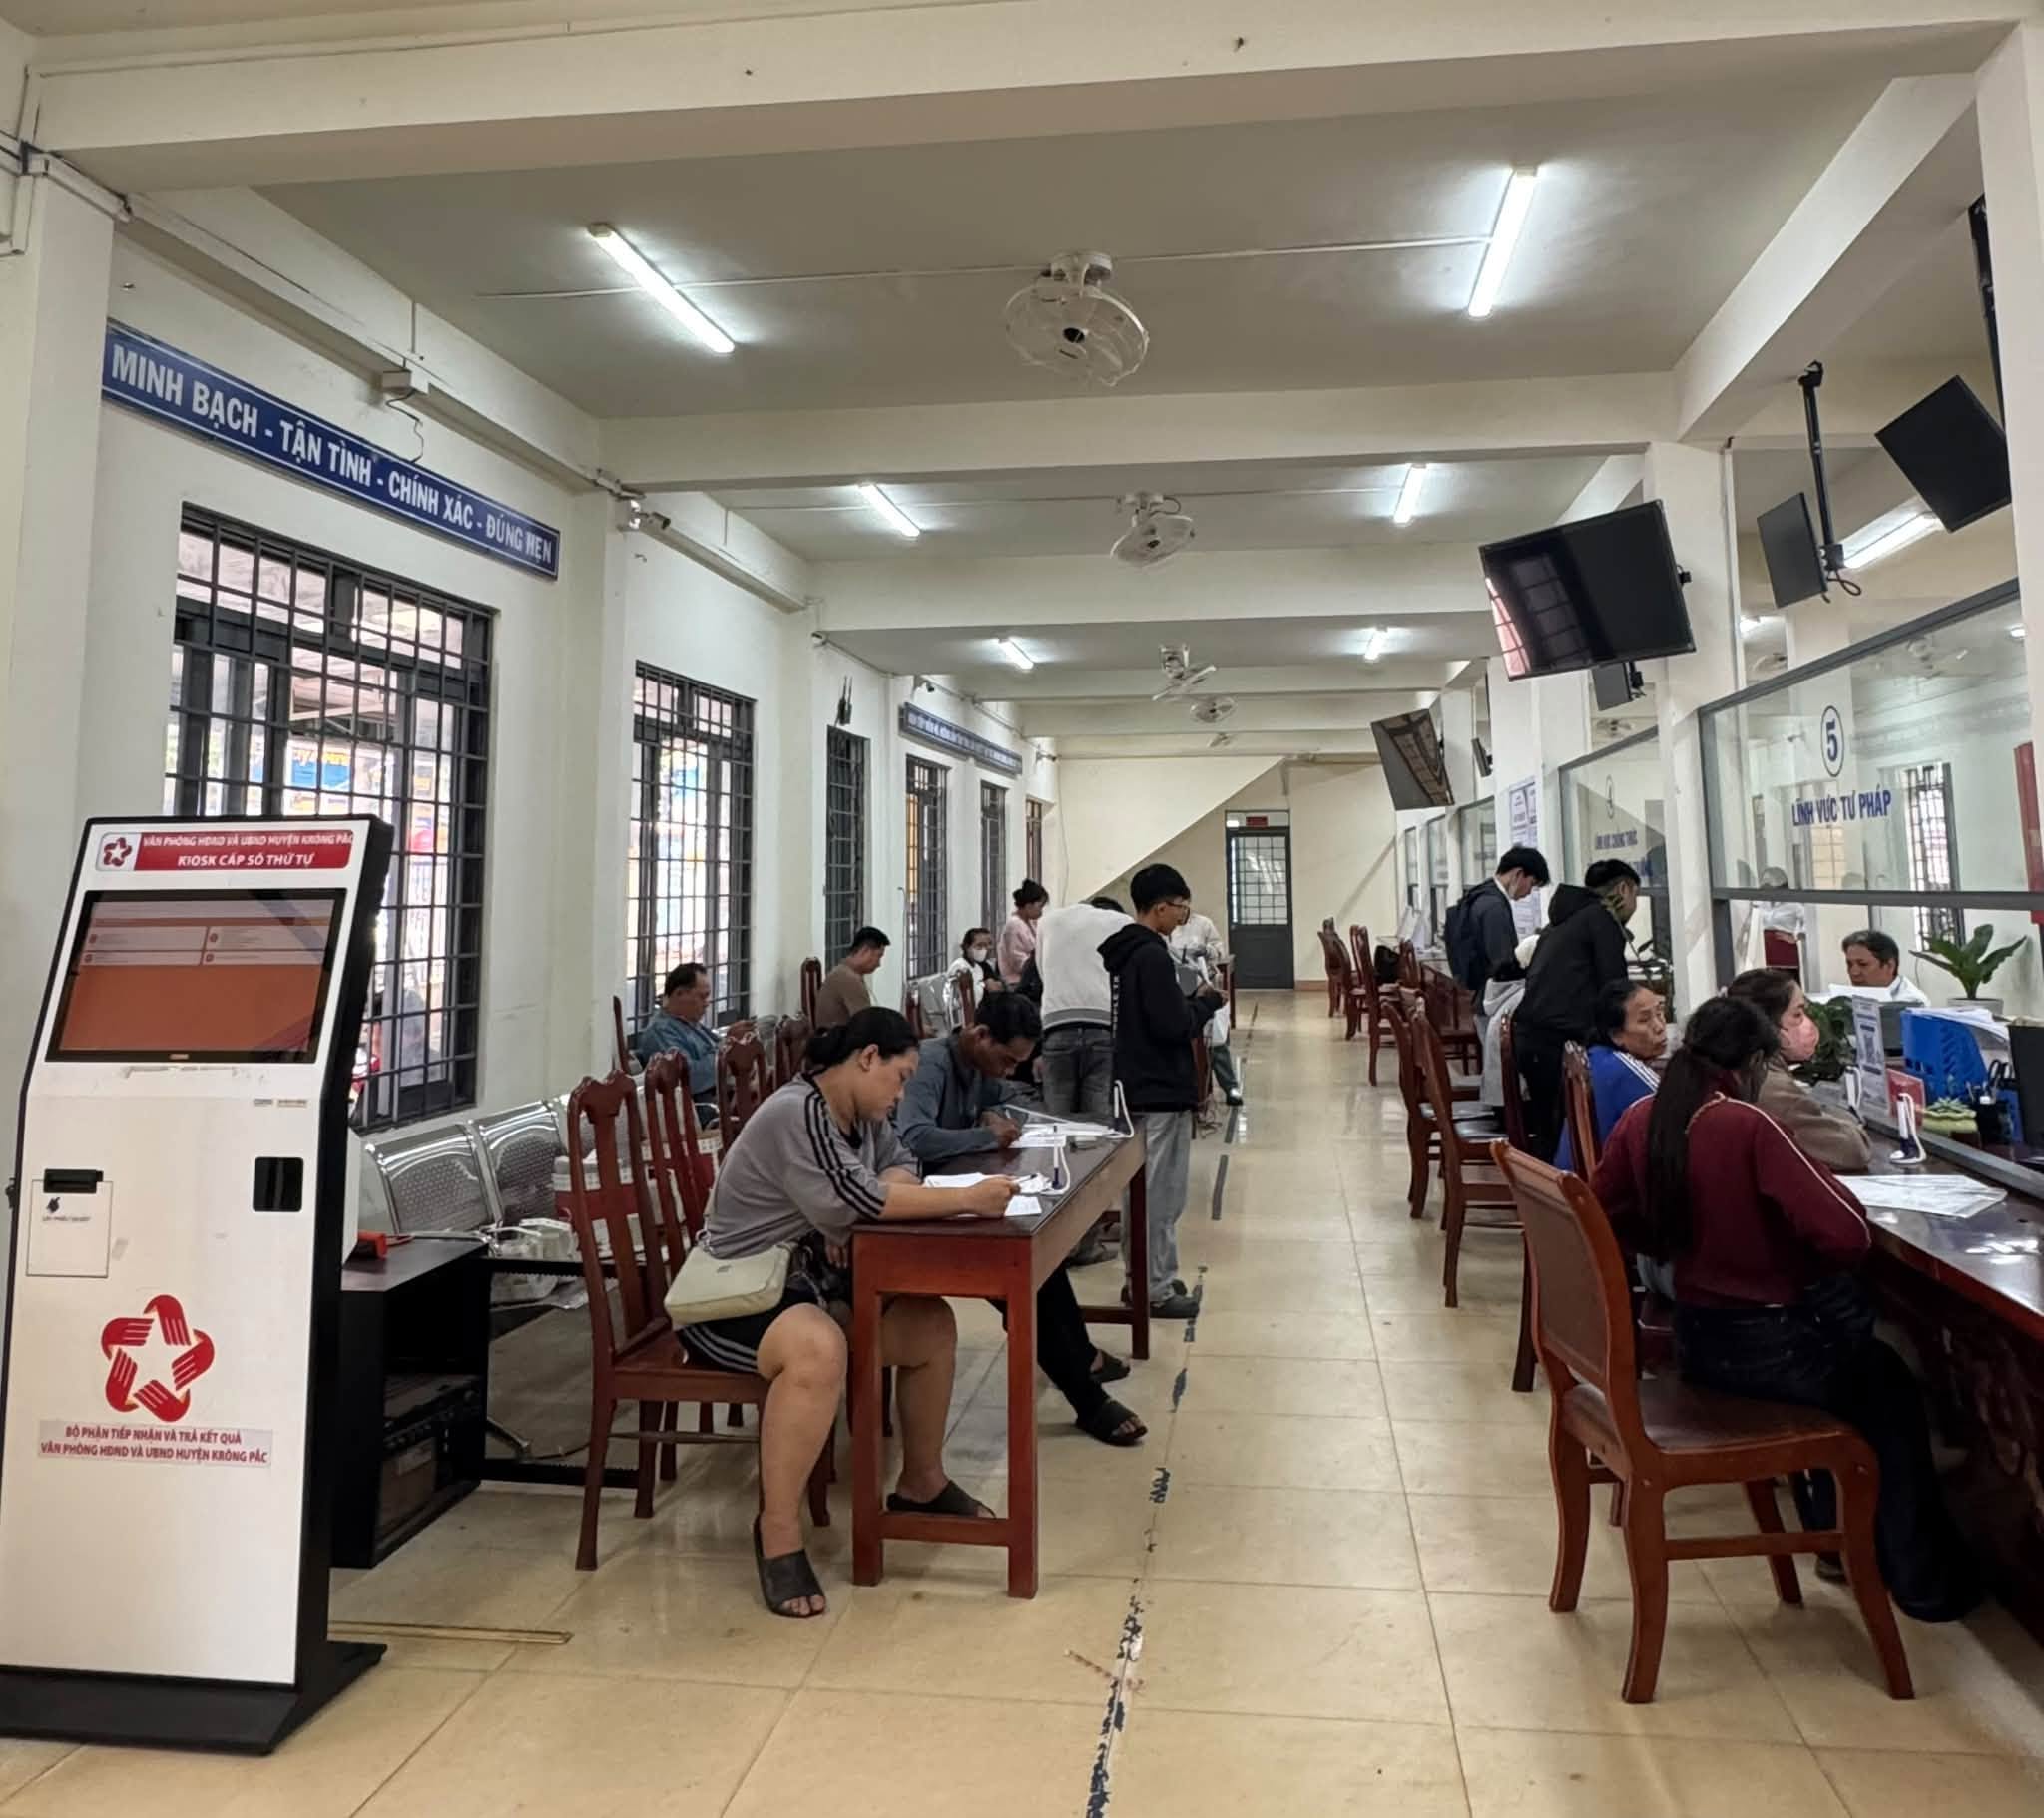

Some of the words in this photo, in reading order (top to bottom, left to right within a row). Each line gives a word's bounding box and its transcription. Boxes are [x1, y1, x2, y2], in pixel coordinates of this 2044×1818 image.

[111, 344, 184, 407] MINH
[192, 380, 258, 438] BẠCH
[279, 418, 322, 466] TẬN
[327, 440, 371, 487] TÌNH
[377, 477, 384, 486] -
[388, 470, 439, 516] CHÍNH
[443, 494, 474, 530] XÁC
[486, 514, 523, 552] ĐÚNG
[526, 532, 552, 564] HẸN
[1825, 718, 1838, 762] 5
[1791, 797, 1814, 826] LĨNH
[1840, 790, 1856, 820] TƯ
[1858, 784, 1891, 818] PHÁP
[178, 855, 218, 867] KIOSK
[219, 852, 246, 866] CẤP
[247, 852, 266, 866] SỐ
[266, 853, 295, 865] THỨ
[296, 853, 314, 868] TỰ
[111, 1427, 132, 1440] TIẾP
[164, 1428, 177, 1441] VÀ
[200, 1429, 220, 1443] KẾT
[221, 1430, 243, 1445] QUẢ
[63, 1442, 98, 1456] PHÒNG
[130, 1443, 144, 1458] VÀ
[146, 1446, 175, 1459] UBND
[176, 1446, 210, 1463] HUYỆN
[212, 1446, 247, 1461] KRÔNG
